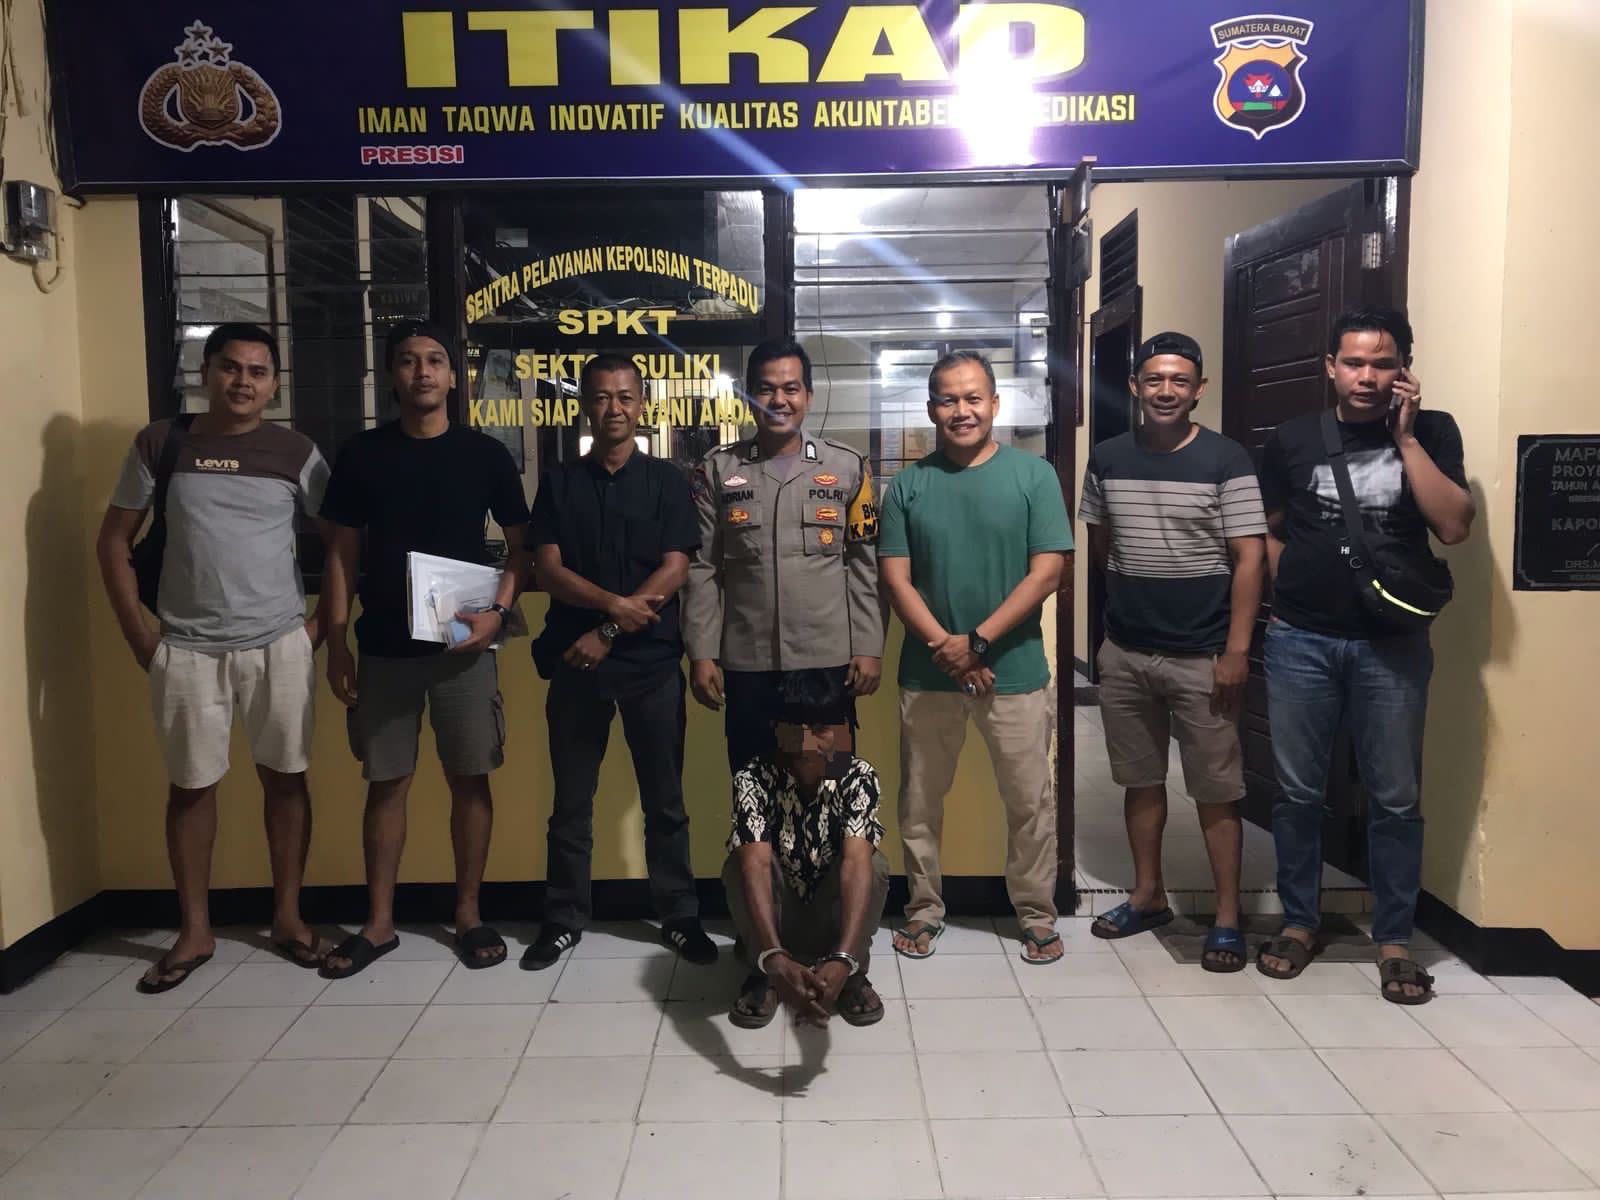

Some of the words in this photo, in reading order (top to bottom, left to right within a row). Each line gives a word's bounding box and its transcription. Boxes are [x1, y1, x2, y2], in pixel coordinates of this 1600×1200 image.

[1217, 24, 1271, 40] SUMATERA
[1272, 23, 1306, 37] BARAT
[402, 3, 1085, 88] ITIKAD
[358, 107, 427, 134] IMAN
[442, 105, 535, 134] TAQWA
[550, 103, 665, 131] INOVATIF
[680, 101, 799, 129] KUALITAS
[814, 98, 948, 128] AKUNTABE
[1036, 95, 1136, 123] EDIKASI
[360, 144, 465, 165] PRESISI
[465, 272, 521, 325] SENTRA
[522, 247, 604, 289] PELAYANAN
[606, 245, 691, 281] KEPOLISIAN
[693, 258, 759, 316] TERPADU
[557, 309, 678, 336] SPKT
[515, 353, 599, 380] SEKT
[631, 353, 721, 380] SULIKI
[469, 398, 524, 427] KAMI
[530, 398, 580, 428] SIAP
[808, 488, 844, 501] POLRI
[1551, 480, 1588, 492] TAHUN
[1551, 517, 1600, 531] KAPO
